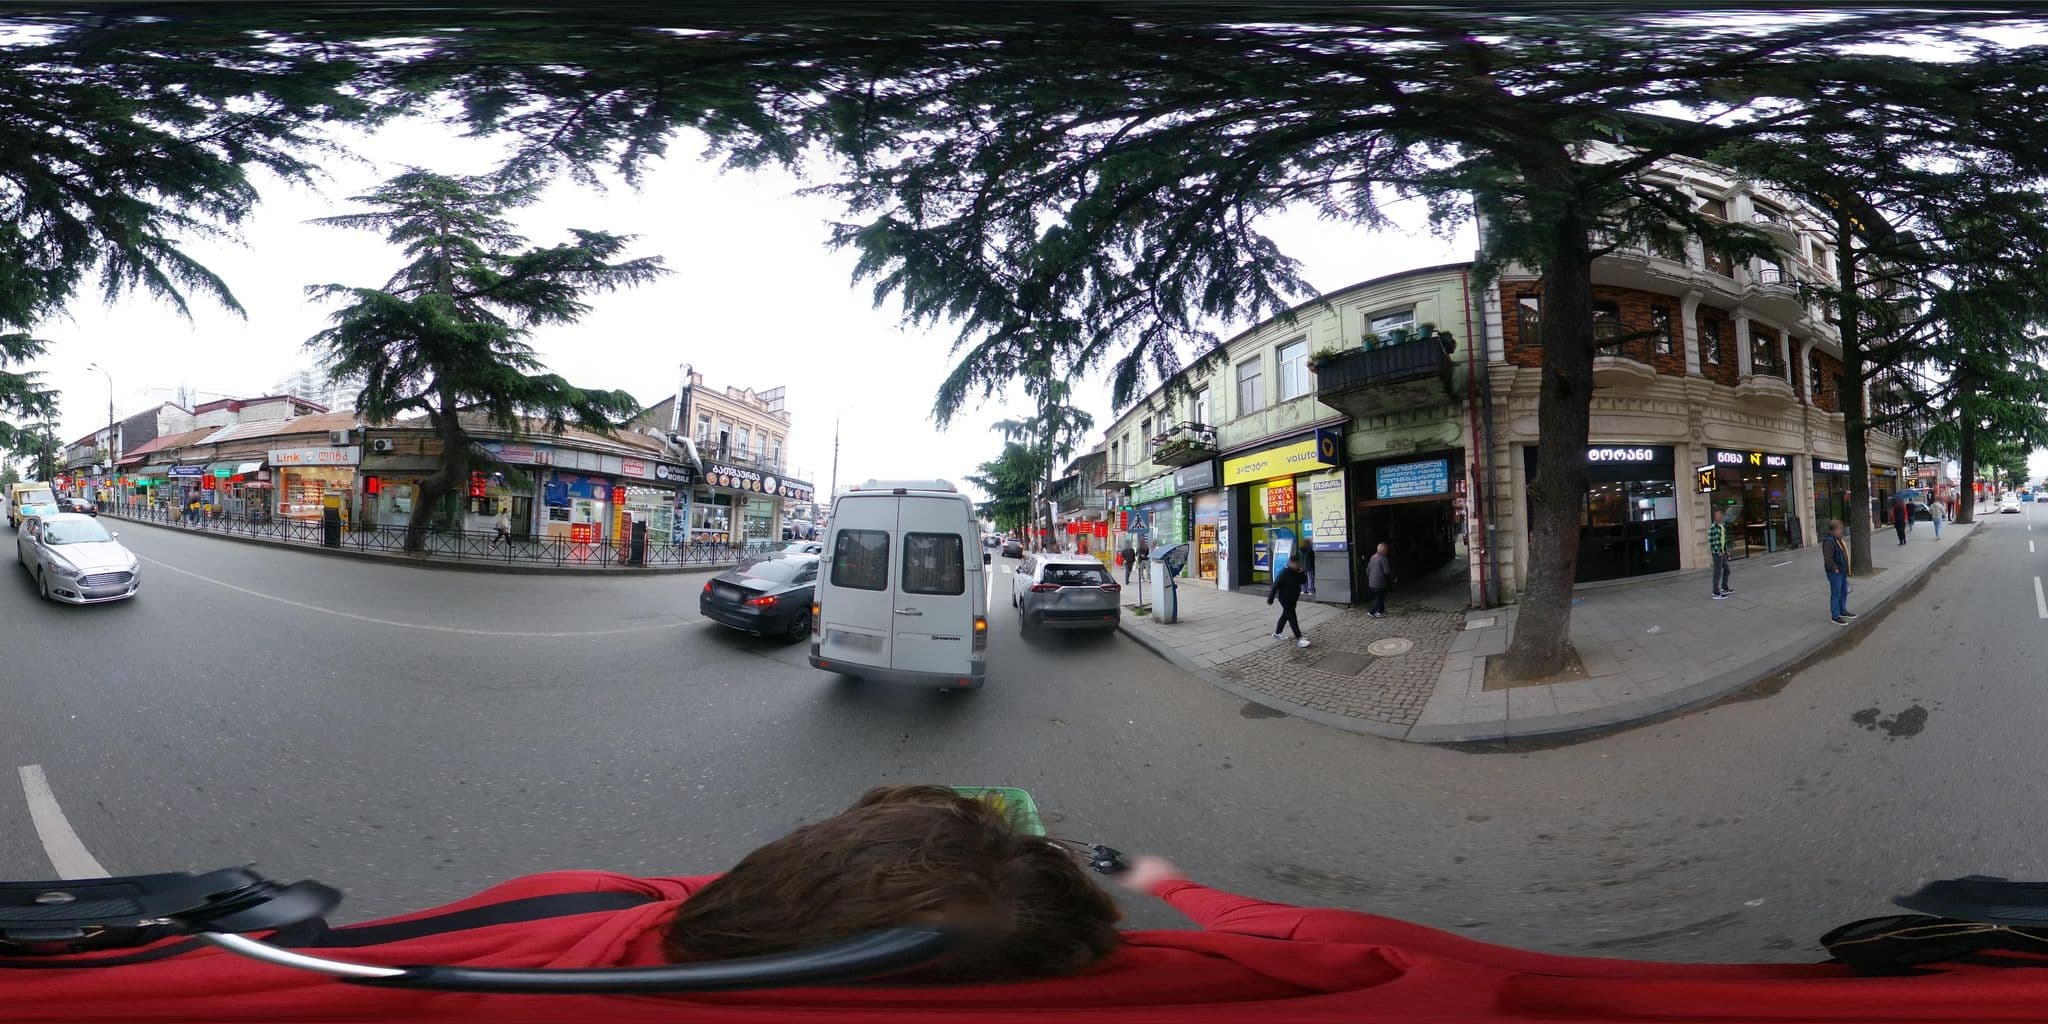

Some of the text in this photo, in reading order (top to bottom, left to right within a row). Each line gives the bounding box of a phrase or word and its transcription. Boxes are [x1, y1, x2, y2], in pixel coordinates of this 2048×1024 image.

[276, 453, 300, 463] Link
[1588, 448, 1653, 461] ტორანი
[1767, 456, 1786, 466] NICA
[1820, 461, 1850, 471] RESTAURAN
[668, 475, 690, 483] MOBILE
